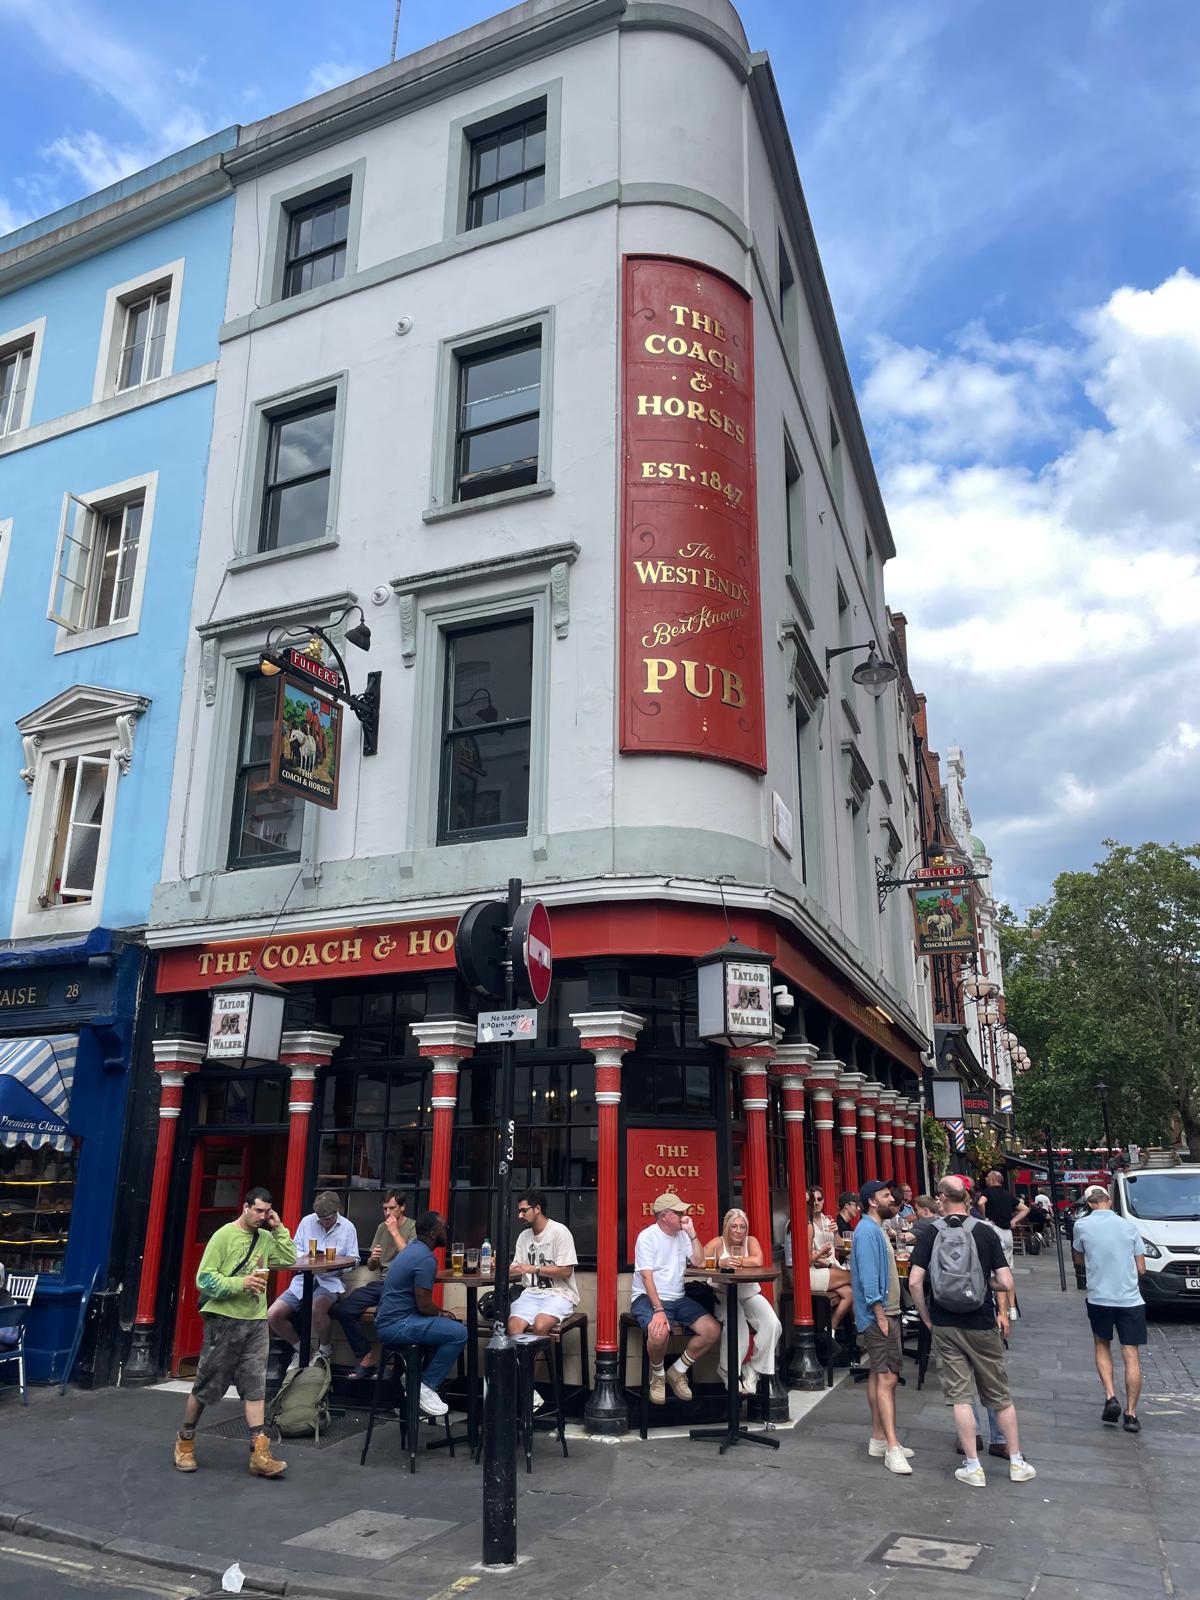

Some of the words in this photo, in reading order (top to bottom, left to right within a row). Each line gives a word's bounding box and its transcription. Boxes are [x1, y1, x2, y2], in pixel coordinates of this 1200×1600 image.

[670, 304, 727, 342] THE
[644, 334, 739, 382] COACH
[690, 371, 712, 392] &
[637, 395, 745, 444] HORSES
[641, 462, 696, 482] EST.
[700, 471, 744, 504] 1847
[679, 543, 716, 560] The
[633, 561, 701, 586] WEST
[703, 567, 750, 606] END'S
[642, 616, 693, 648] Best
[692, 605, 743, 633] Known
[643, 658, 746, 708] PUB
[281, 769, 302, 784] COACH
[302, 779, 308, 787] &
[308, 780, 331, 795] HORSES
[301, 769, 314, 780] THE
[198, 951, 252, 975] THE
[261, 938, 363, 970] COACH
[372, 934, 397, 961] &
[731, 968, 765, 982] TAYLOR
[0, 986, 37, 1006] AISE
[66, 983, 79, 998] 28
[218, 998, 245, 1010] TAYLOR
[730, 1012, 768, 1027] WALKER
[213, 1038, 242, 1050] WALKER
[38, 1120, 66, 1132] Classe
[657, 1144, 689, 1157] THE
[644, 1163, 700, 1177] COACH
